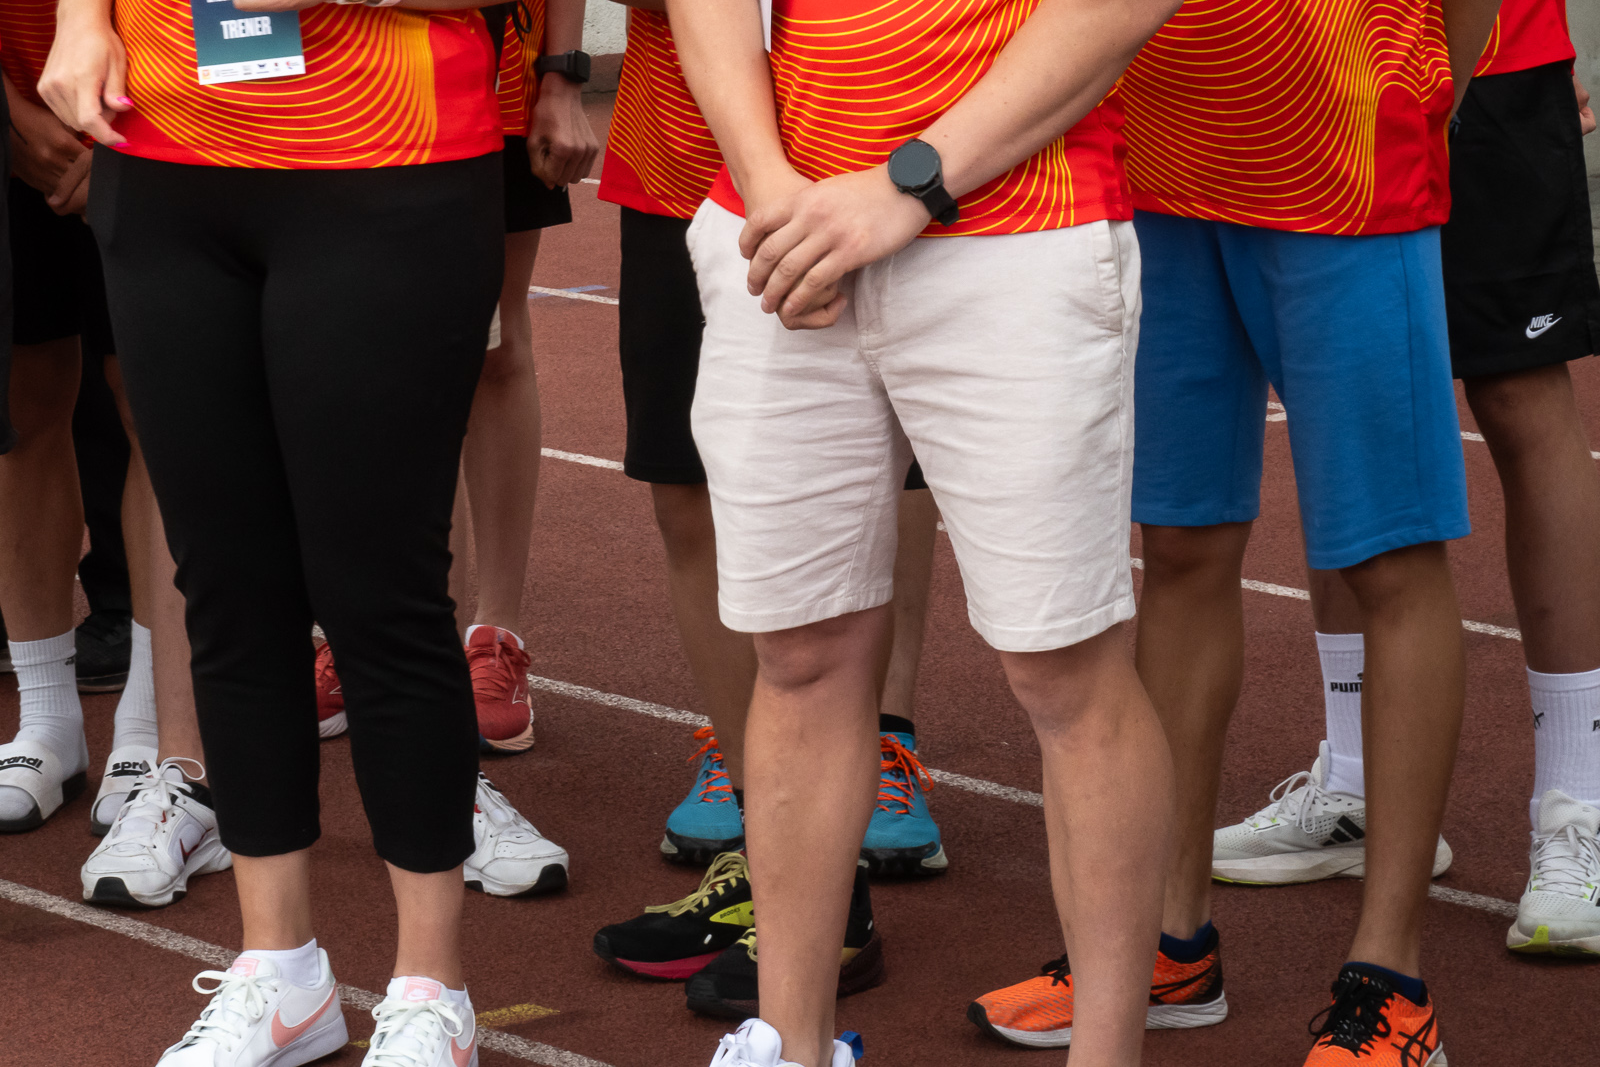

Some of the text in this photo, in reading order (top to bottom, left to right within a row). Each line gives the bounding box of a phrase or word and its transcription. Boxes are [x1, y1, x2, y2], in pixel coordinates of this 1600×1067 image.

[220, 15, 273, 40] TRENER
[1530, 313, 1553, 329] NIKE
[1330, 681, 1362, 693] PUM
